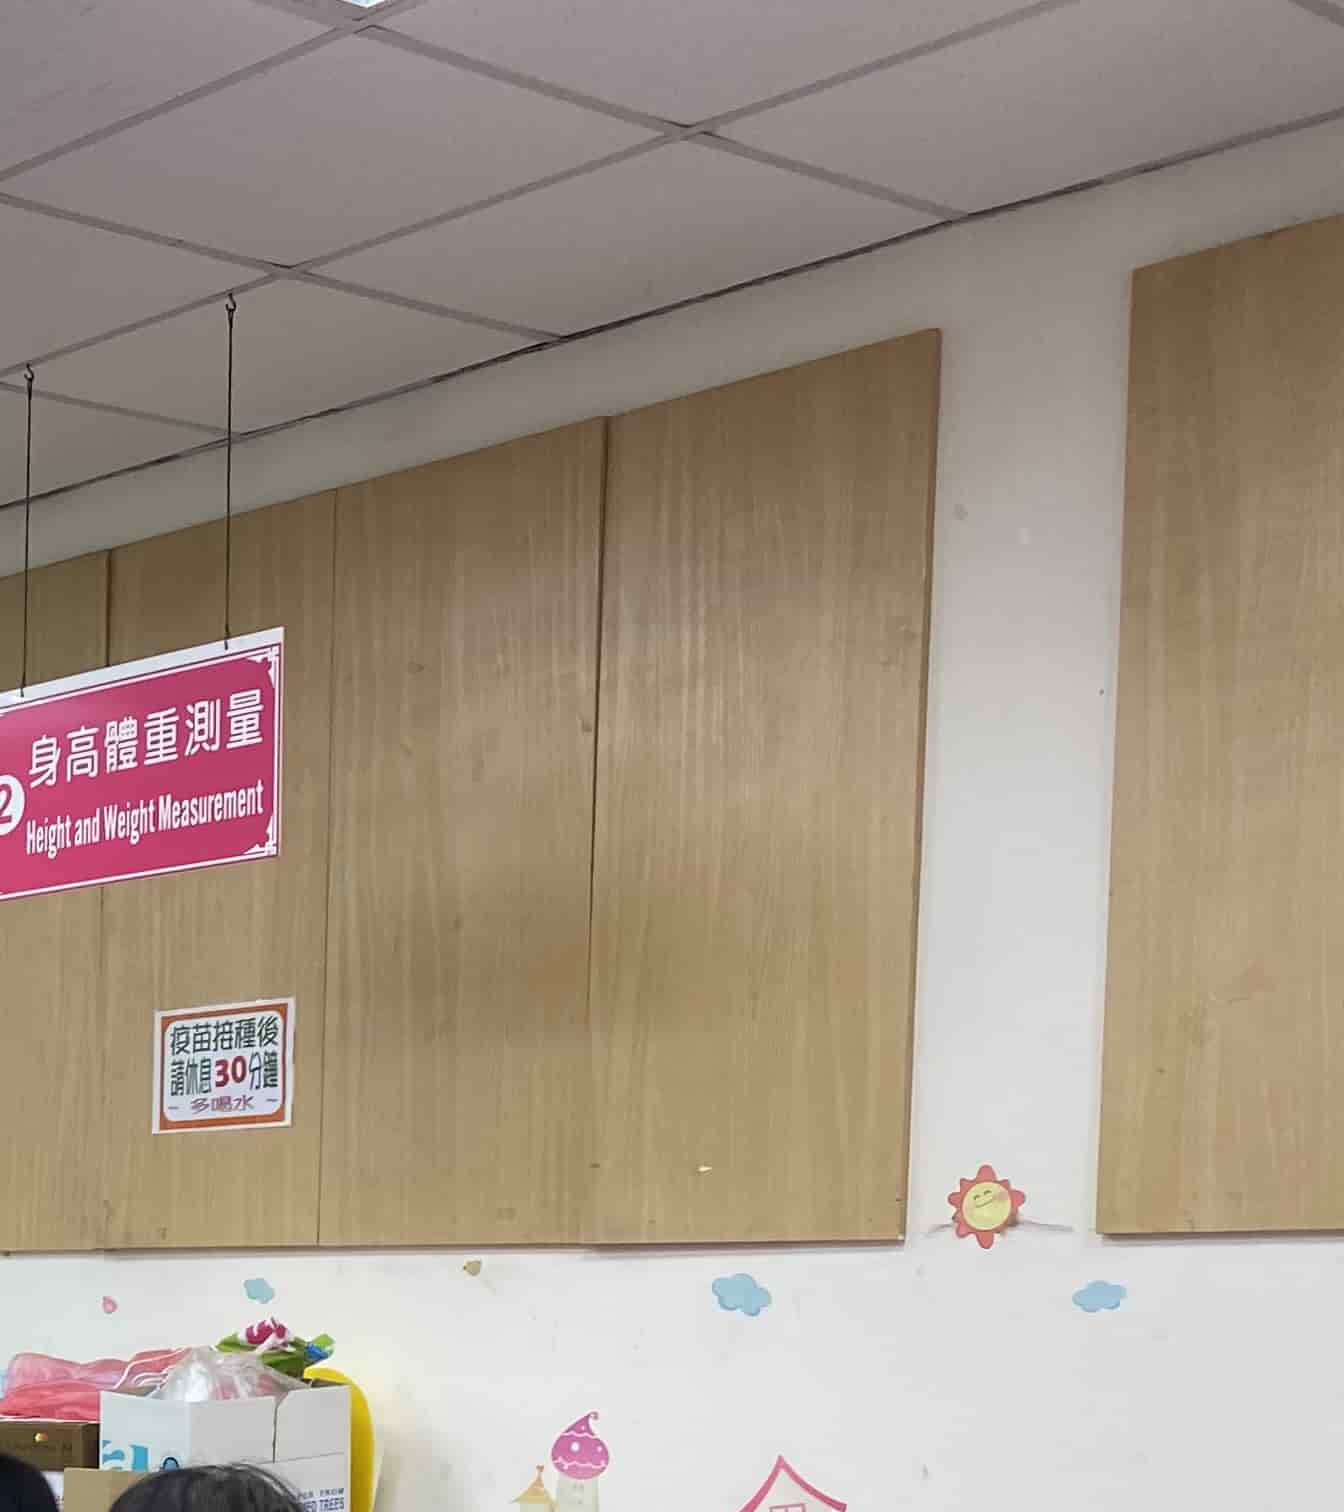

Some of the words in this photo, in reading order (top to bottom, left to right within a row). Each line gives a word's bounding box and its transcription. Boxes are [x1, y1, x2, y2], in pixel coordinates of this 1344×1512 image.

[28, 688, 264, 789] 身高體重測量
[26, 815, 72, 859] Height
[74, 808, 100, 847] and
[103, 799, 155, 845] Weight
[159, 779, 264, 832] Measurement
[170, 1015, 280, 1056] 疫苗接種後
